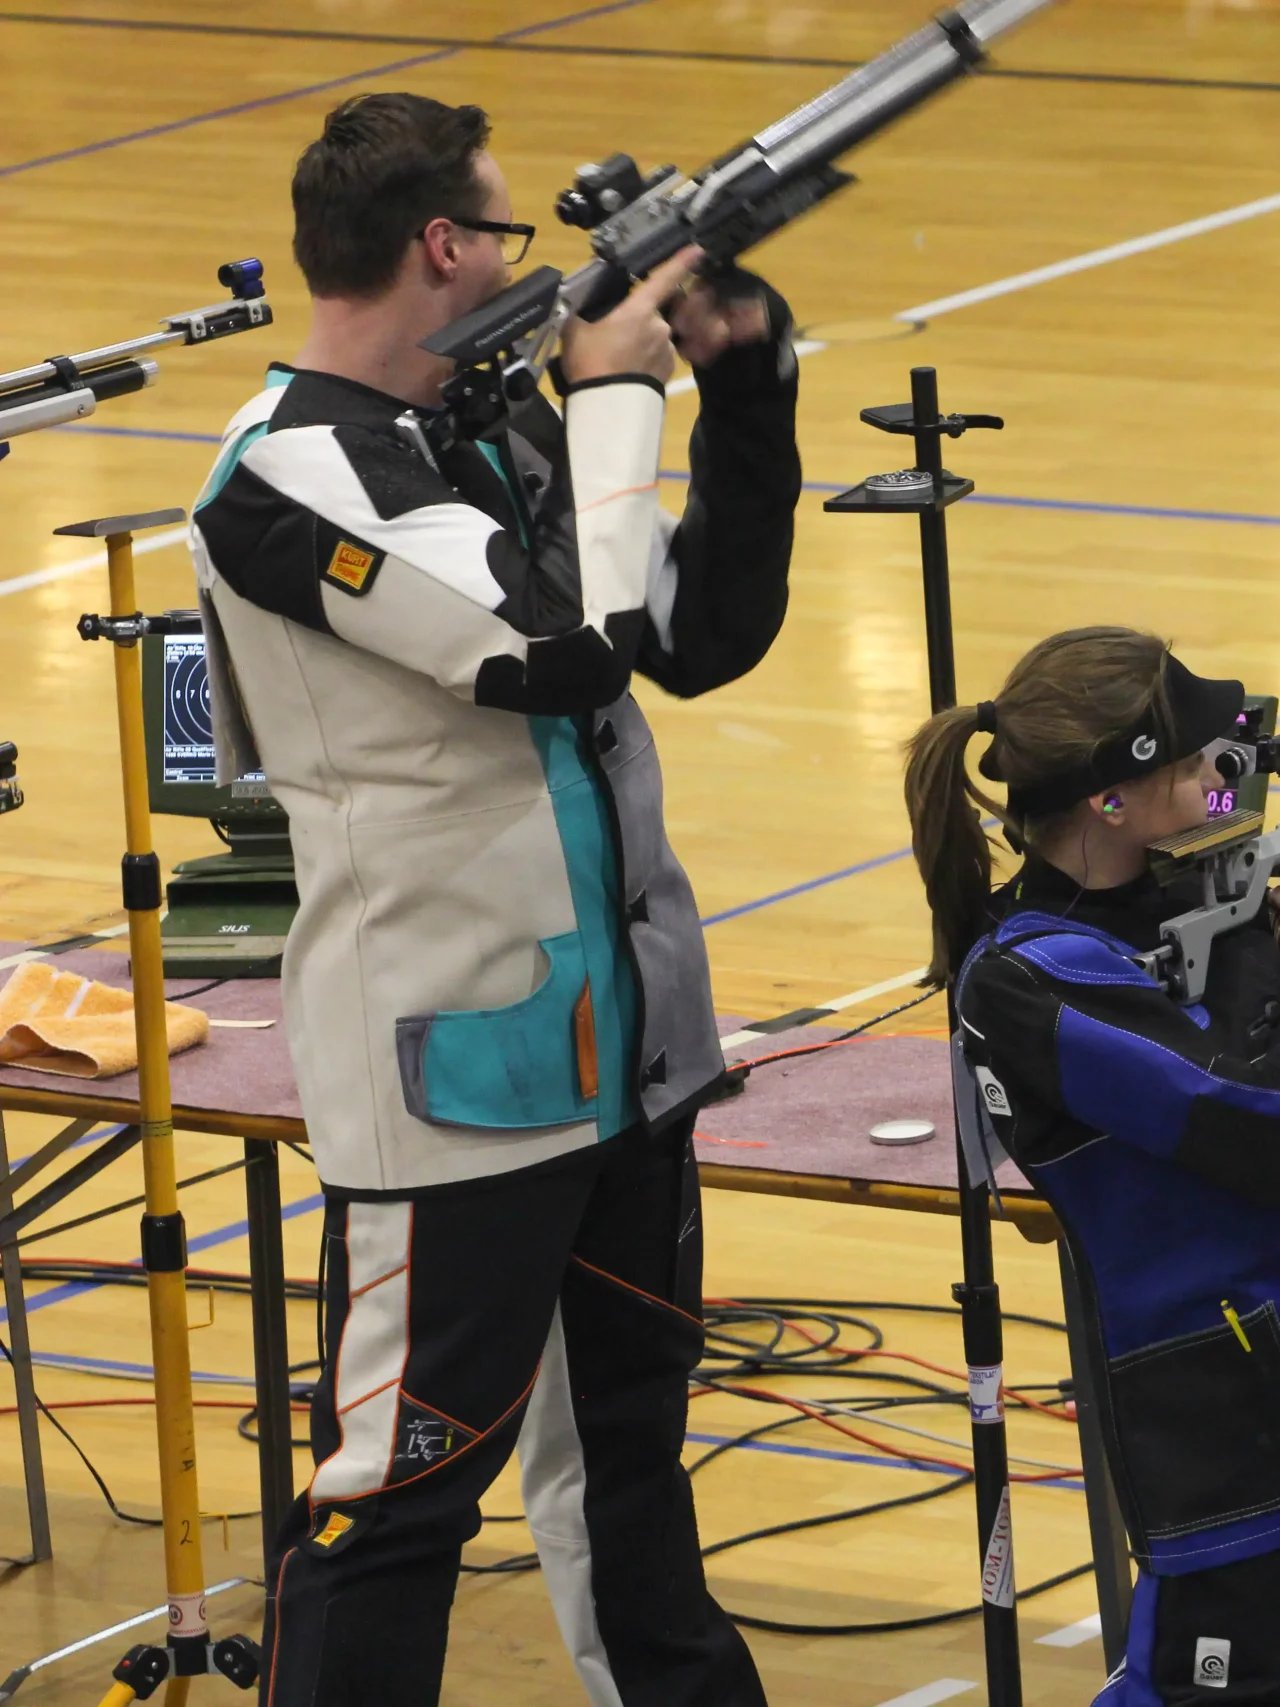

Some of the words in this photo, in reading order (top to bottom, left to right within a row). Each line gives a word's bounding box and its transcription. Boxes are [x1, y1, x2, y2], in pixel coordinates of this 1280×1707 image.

[342, 549, 366, 566] KURT
[190, 690, 195, 699] 7
[219, 924, 250, 933] SIUS
[180, 1520, 193, 1545] 2
